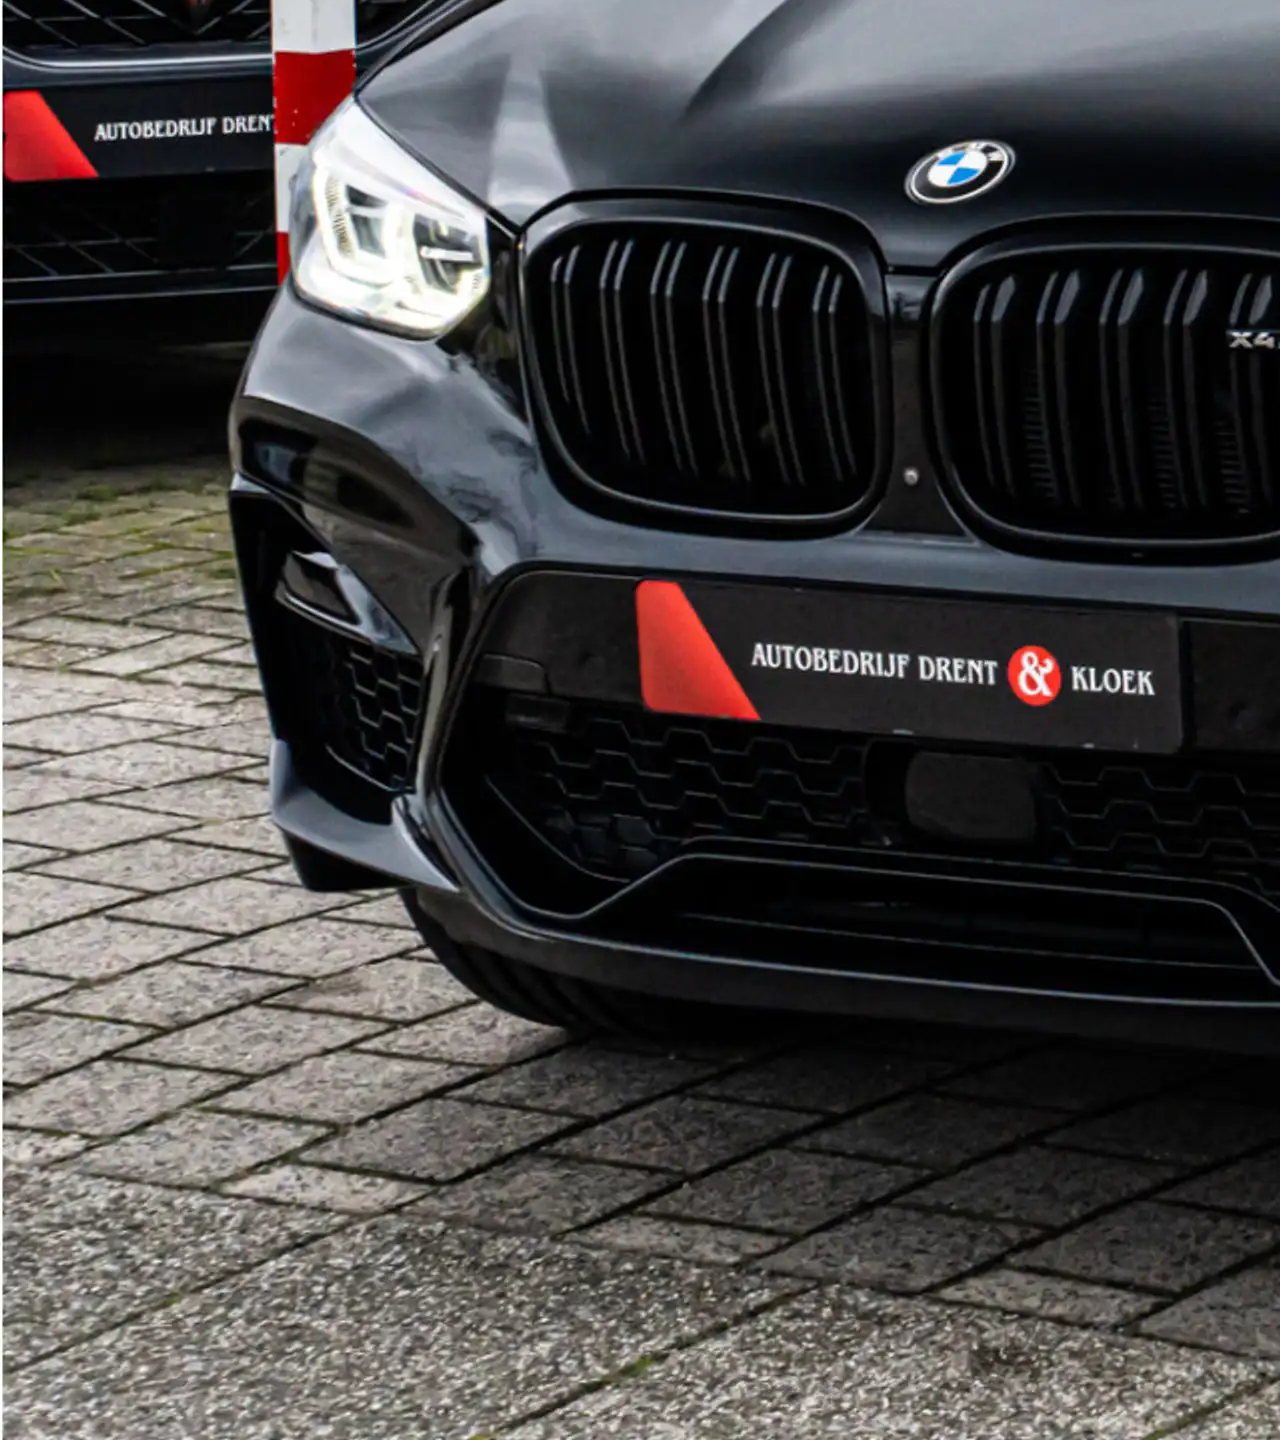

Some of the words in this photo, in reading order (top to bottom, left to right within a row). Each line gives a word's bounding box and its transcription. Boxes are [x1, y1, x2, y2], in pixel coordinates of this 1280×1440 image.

[94, 117, 217, 142] AUTOBEDRIJF
[222, 113, 274, 135] DREN
[751, 642, 912, 680] AUTOBEDRIJF
[918, 654, 998, 687] DRENT
[1017, 650, 1055, 697] &
[1071, 665, 1156, 697] KLOEK
